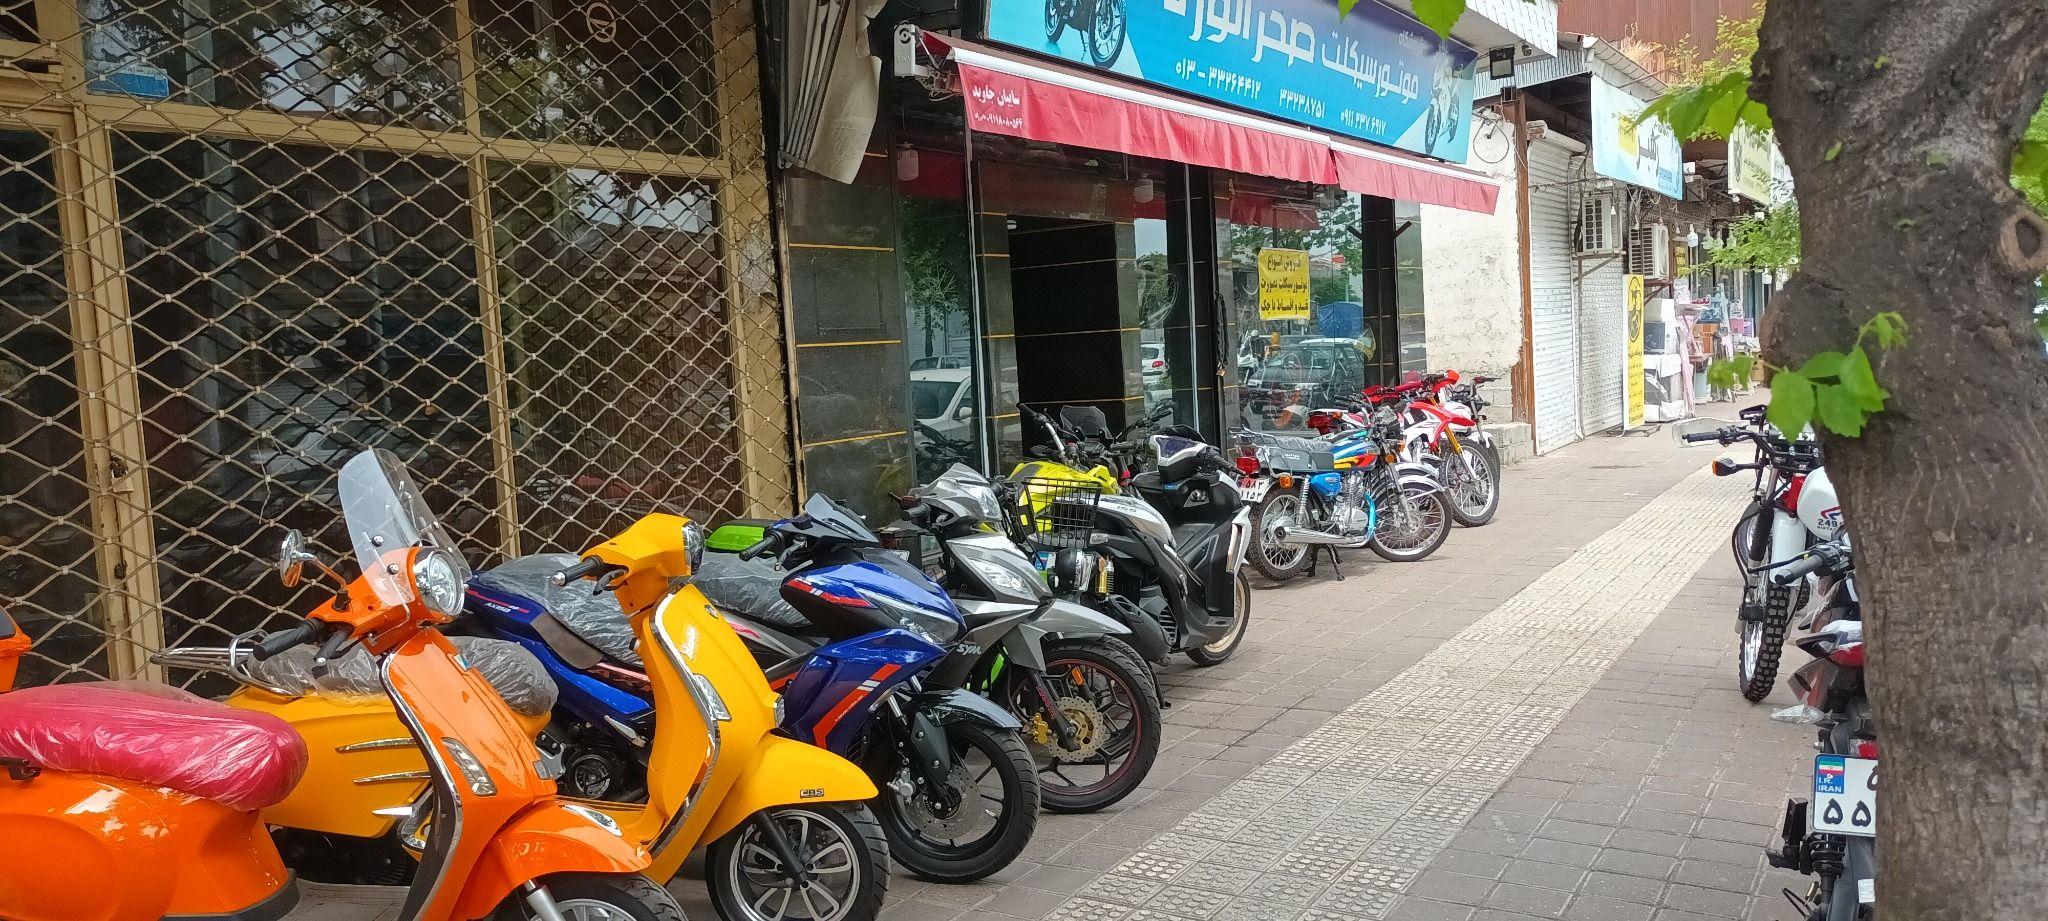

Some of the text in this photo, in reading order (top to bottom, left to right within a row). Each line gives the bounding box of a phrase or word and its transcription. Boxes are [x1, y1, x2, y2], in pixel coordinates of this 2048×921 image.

[1175, 57, 1196, 80] ۰۱۳
[1321, 29, 1419, 105] موتورسیکلت
[972, 84, 1020, 107] سایبان جاوید
[1267, 254, 1301, 271] فروش انواع
[956, 643, 982, 655] SYM
[1818, 785, 1842, 793] IRAN
